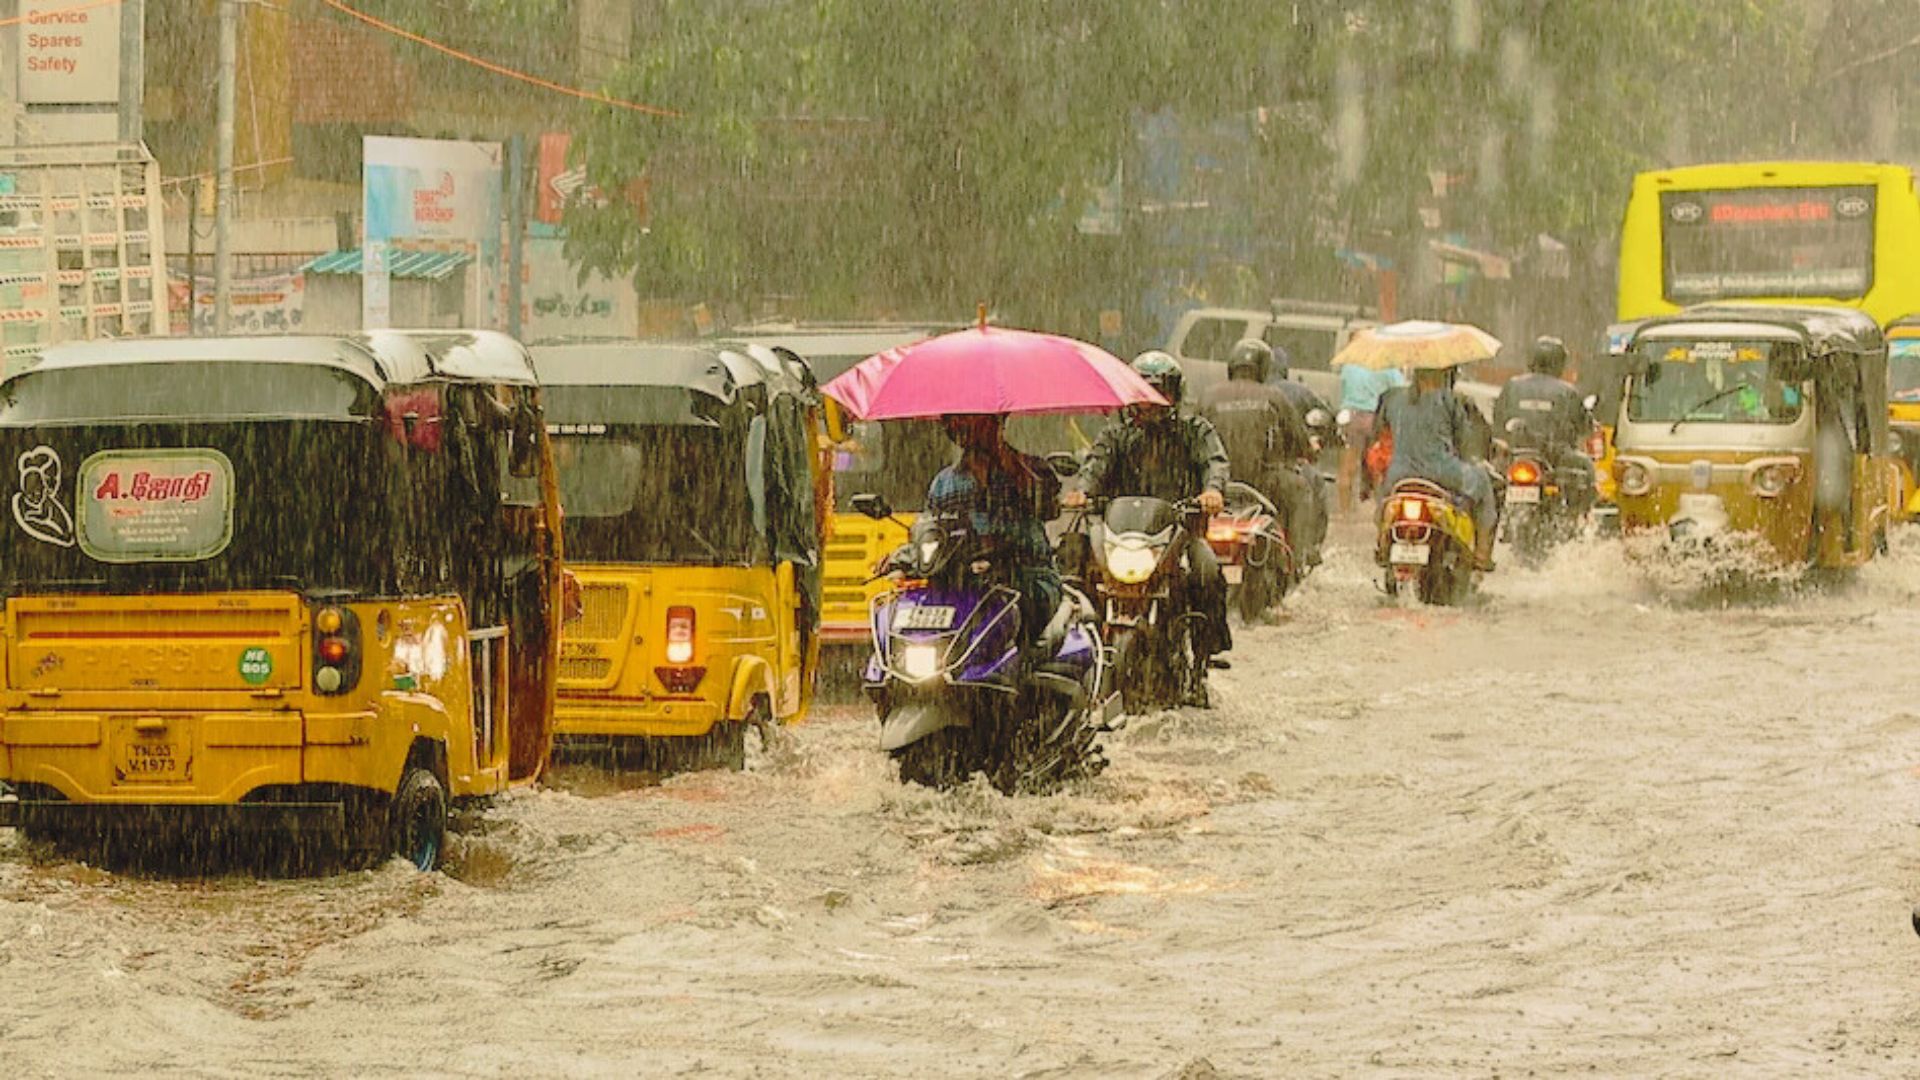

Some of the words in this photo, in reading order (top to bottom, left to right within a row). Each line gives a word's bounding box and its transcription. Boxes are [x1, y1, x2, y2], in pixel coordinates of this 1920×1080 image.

[29, 10, 88, 24] Service
[28, 34, 82, 50] Spares
[28, 56, 76, 74] Safety
[77, 648, 226, 674] PIAGGIO
